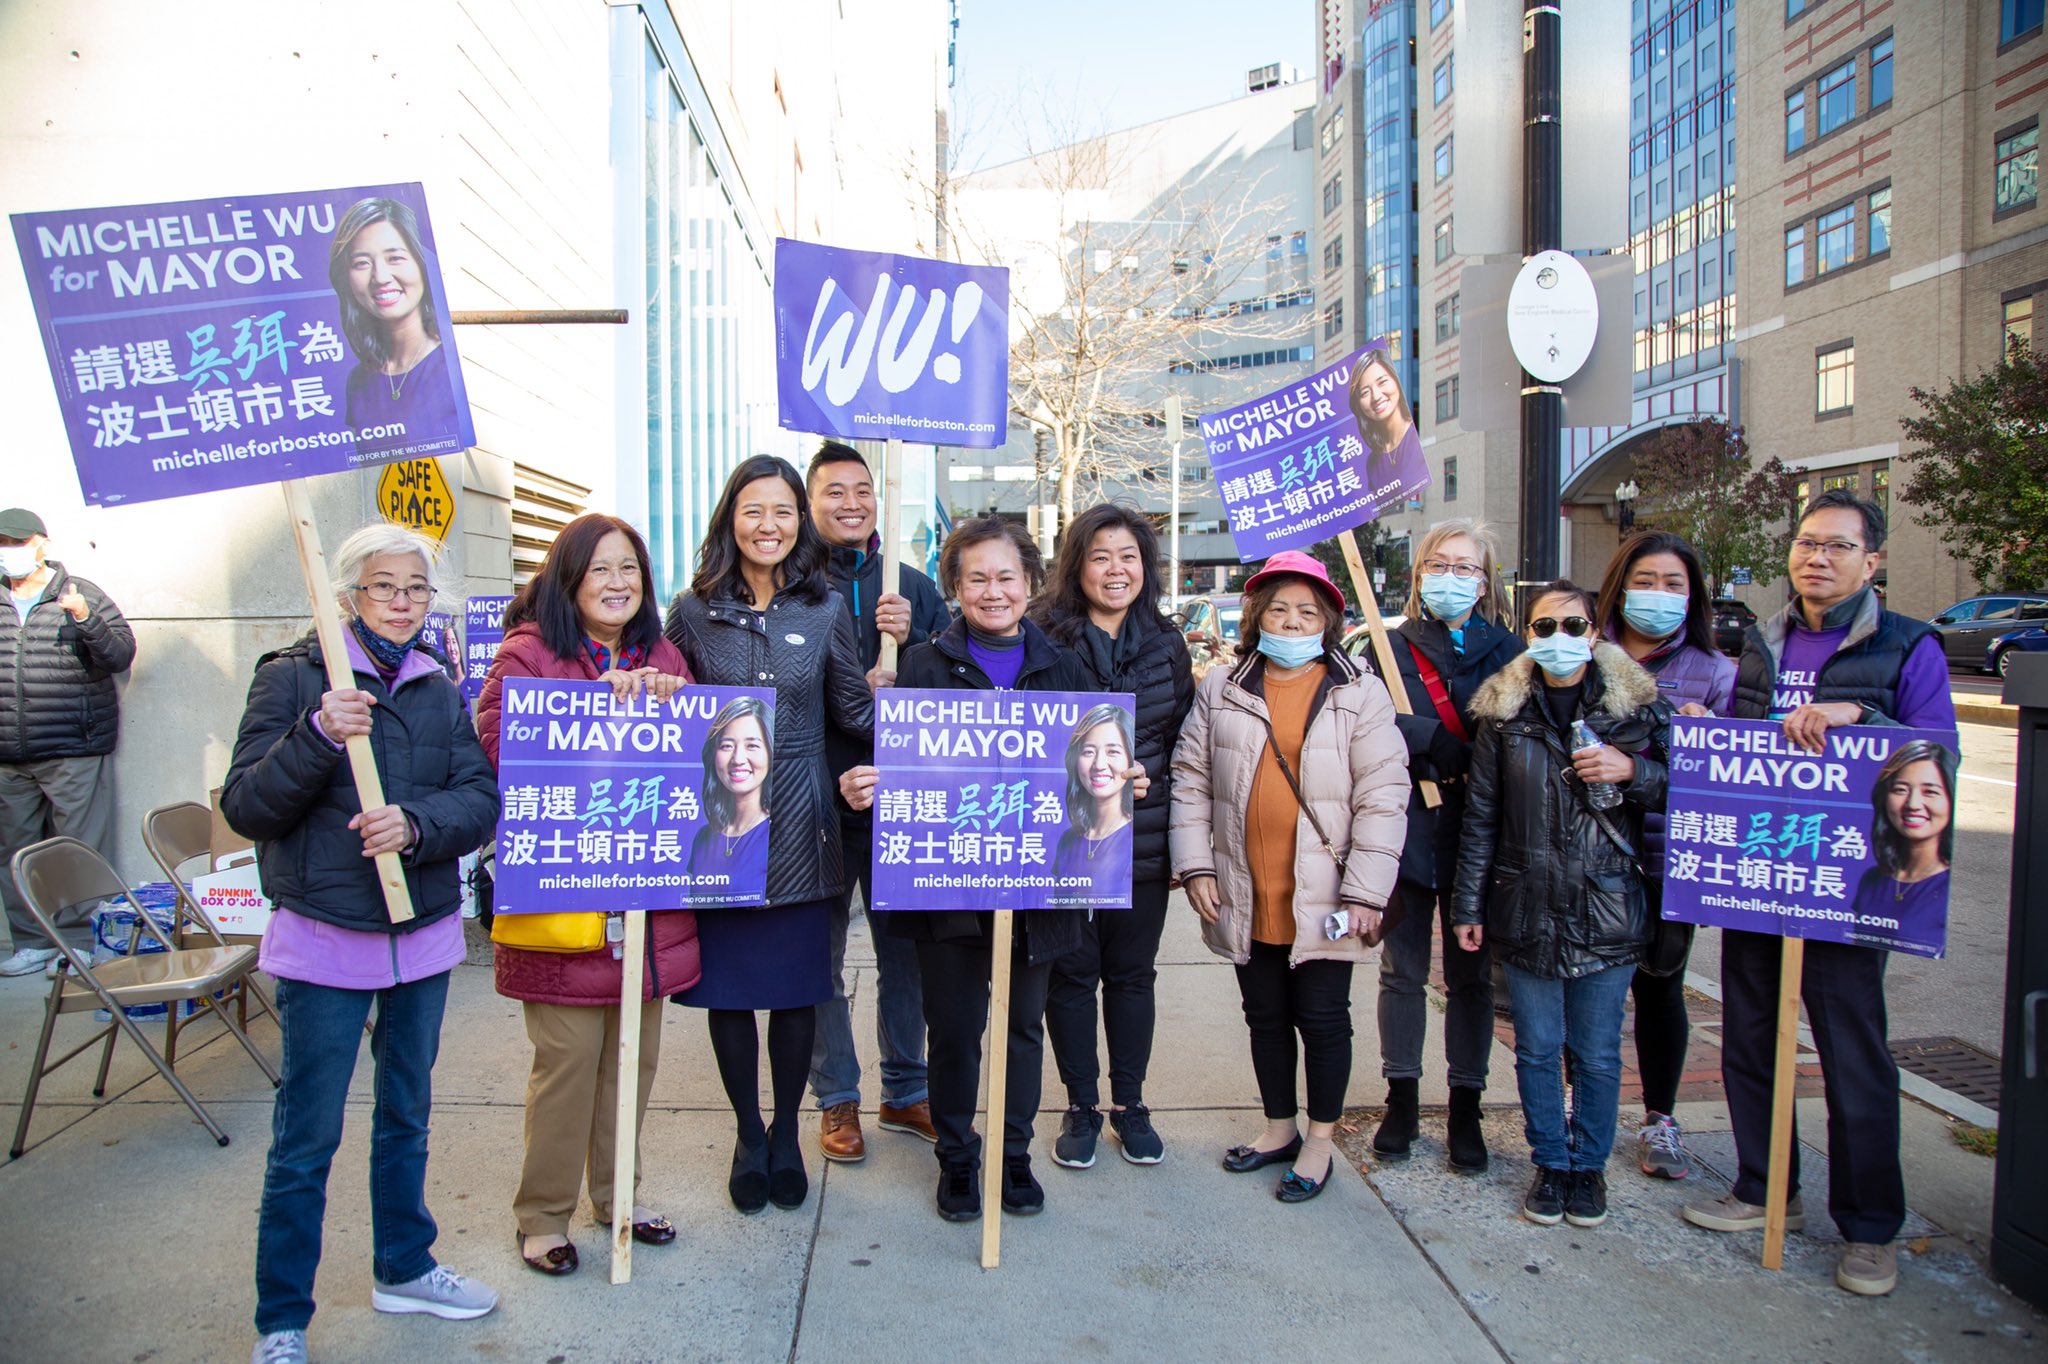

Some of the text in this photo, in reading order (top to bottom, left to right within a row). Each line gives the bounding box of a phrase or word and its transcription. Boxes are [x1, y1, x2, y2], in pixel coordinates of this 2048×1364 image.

[36, 204, 337, 258] MICHELLE WU
[50, 245, 302, 298] for MAYOR
[87, 377, 335, 449] 波士頓市長
[1202, 366, 1350, 438] MICHELLE WU
[854, 412, 995, 432] michelleforboston.com
[1209, 399, 1336, 454] for MAYOR
[152, 421, 406, 472] michelleforboston.com
[349, 455, 364, 463] PAID
[391, 448, 404, 456] THE
[405, 446, 417, 454] WU
[418, 440, 456, 451] COMMITTEE
[397, 460, 431, 492] SAFE
[1230, 467, 1362, 532] 波士頓市長
[1265, 478, 1402, 542] michelleforboston.com
[468, 601, 511, 613] MICH
[469, 615, 485, 625] for
[507, 689, 717, 720] MICHELLE WU
[880, 699, 1079, 727] MICHELLE WU
[507, 720, 683, 753] for MAYOR
[880, 728, 1047, 759] for MAYOR
[1673, 726, 1889, 761] MICHELL WU
[1673, 753, 1849, 792] for MAYOR
[502, 829, 682, 866] 波士頓市長
[878, 831, 1047, 865] 波士頓市長
[539, 872, 730, 889] michelleforboston.com
[914, 873, 1092, 888] michelleforboston.com
[1669, 847, 1847, 899] 波士頓市長
[201, 897, 224, 906] BOX
[209, 888, 256, 897] DUNKIN'
[735, 894, 760, 902] COMMITTEE
[1701, 893, 1899, 930] michelleforboston.com
